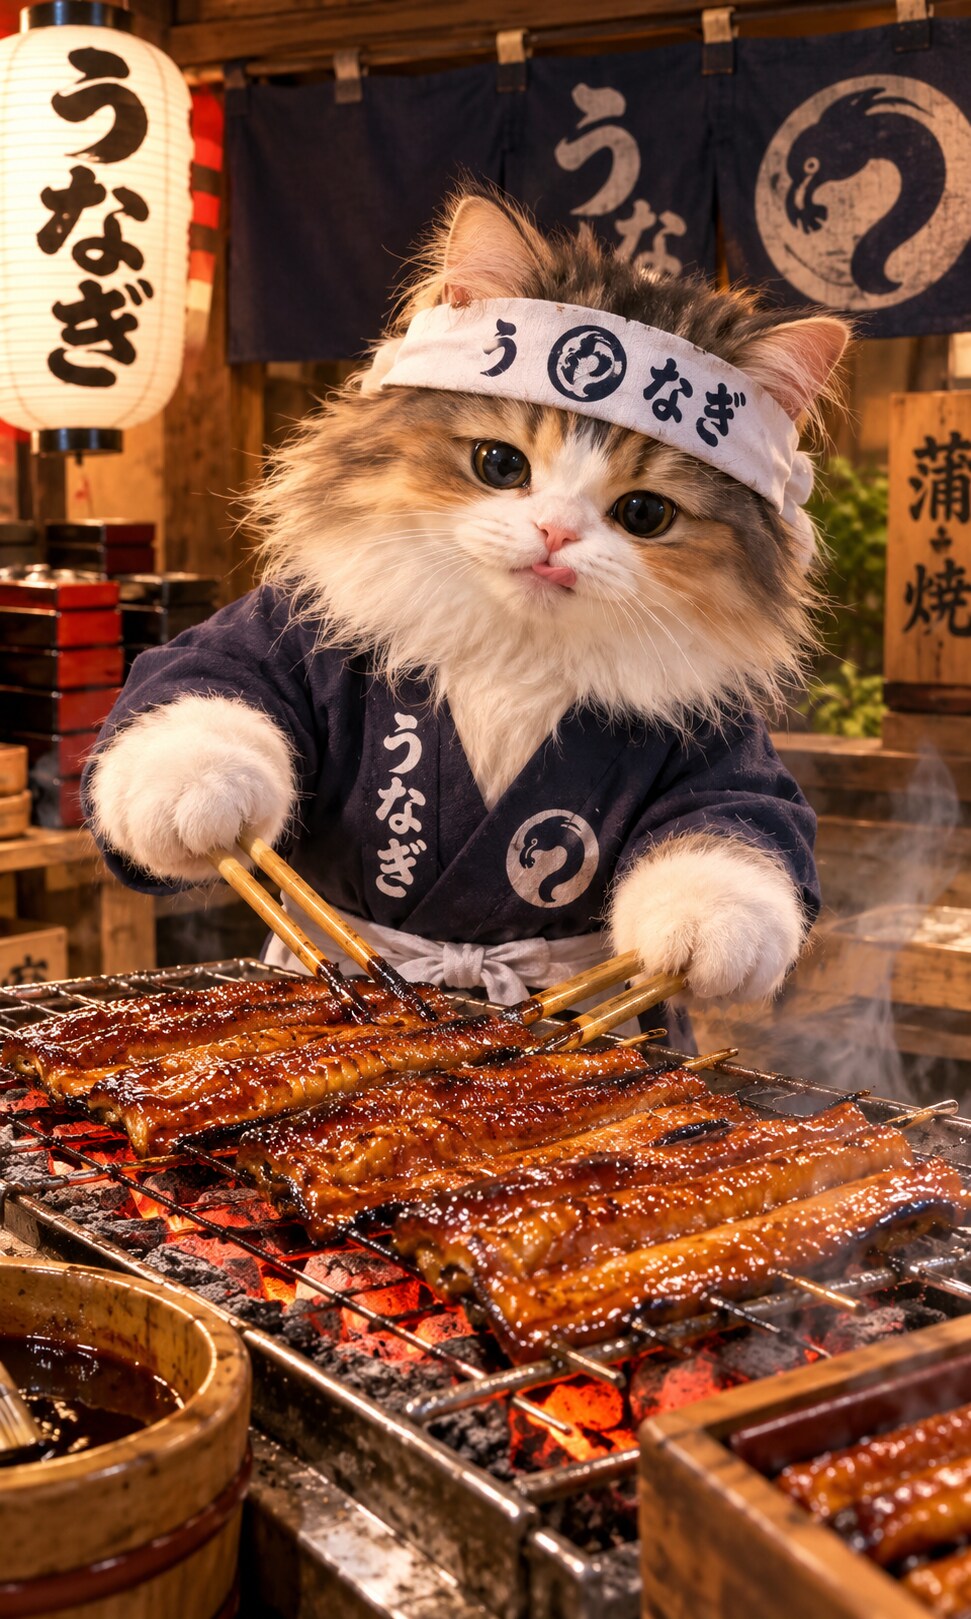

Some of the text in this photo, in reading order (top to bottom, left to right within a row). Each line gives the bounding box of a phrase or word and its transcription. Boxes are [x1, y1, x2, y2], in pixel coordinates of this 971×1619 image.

[36, 46, 154, 388] うなぎ
[375, 711, 428, 899] うなぎ
